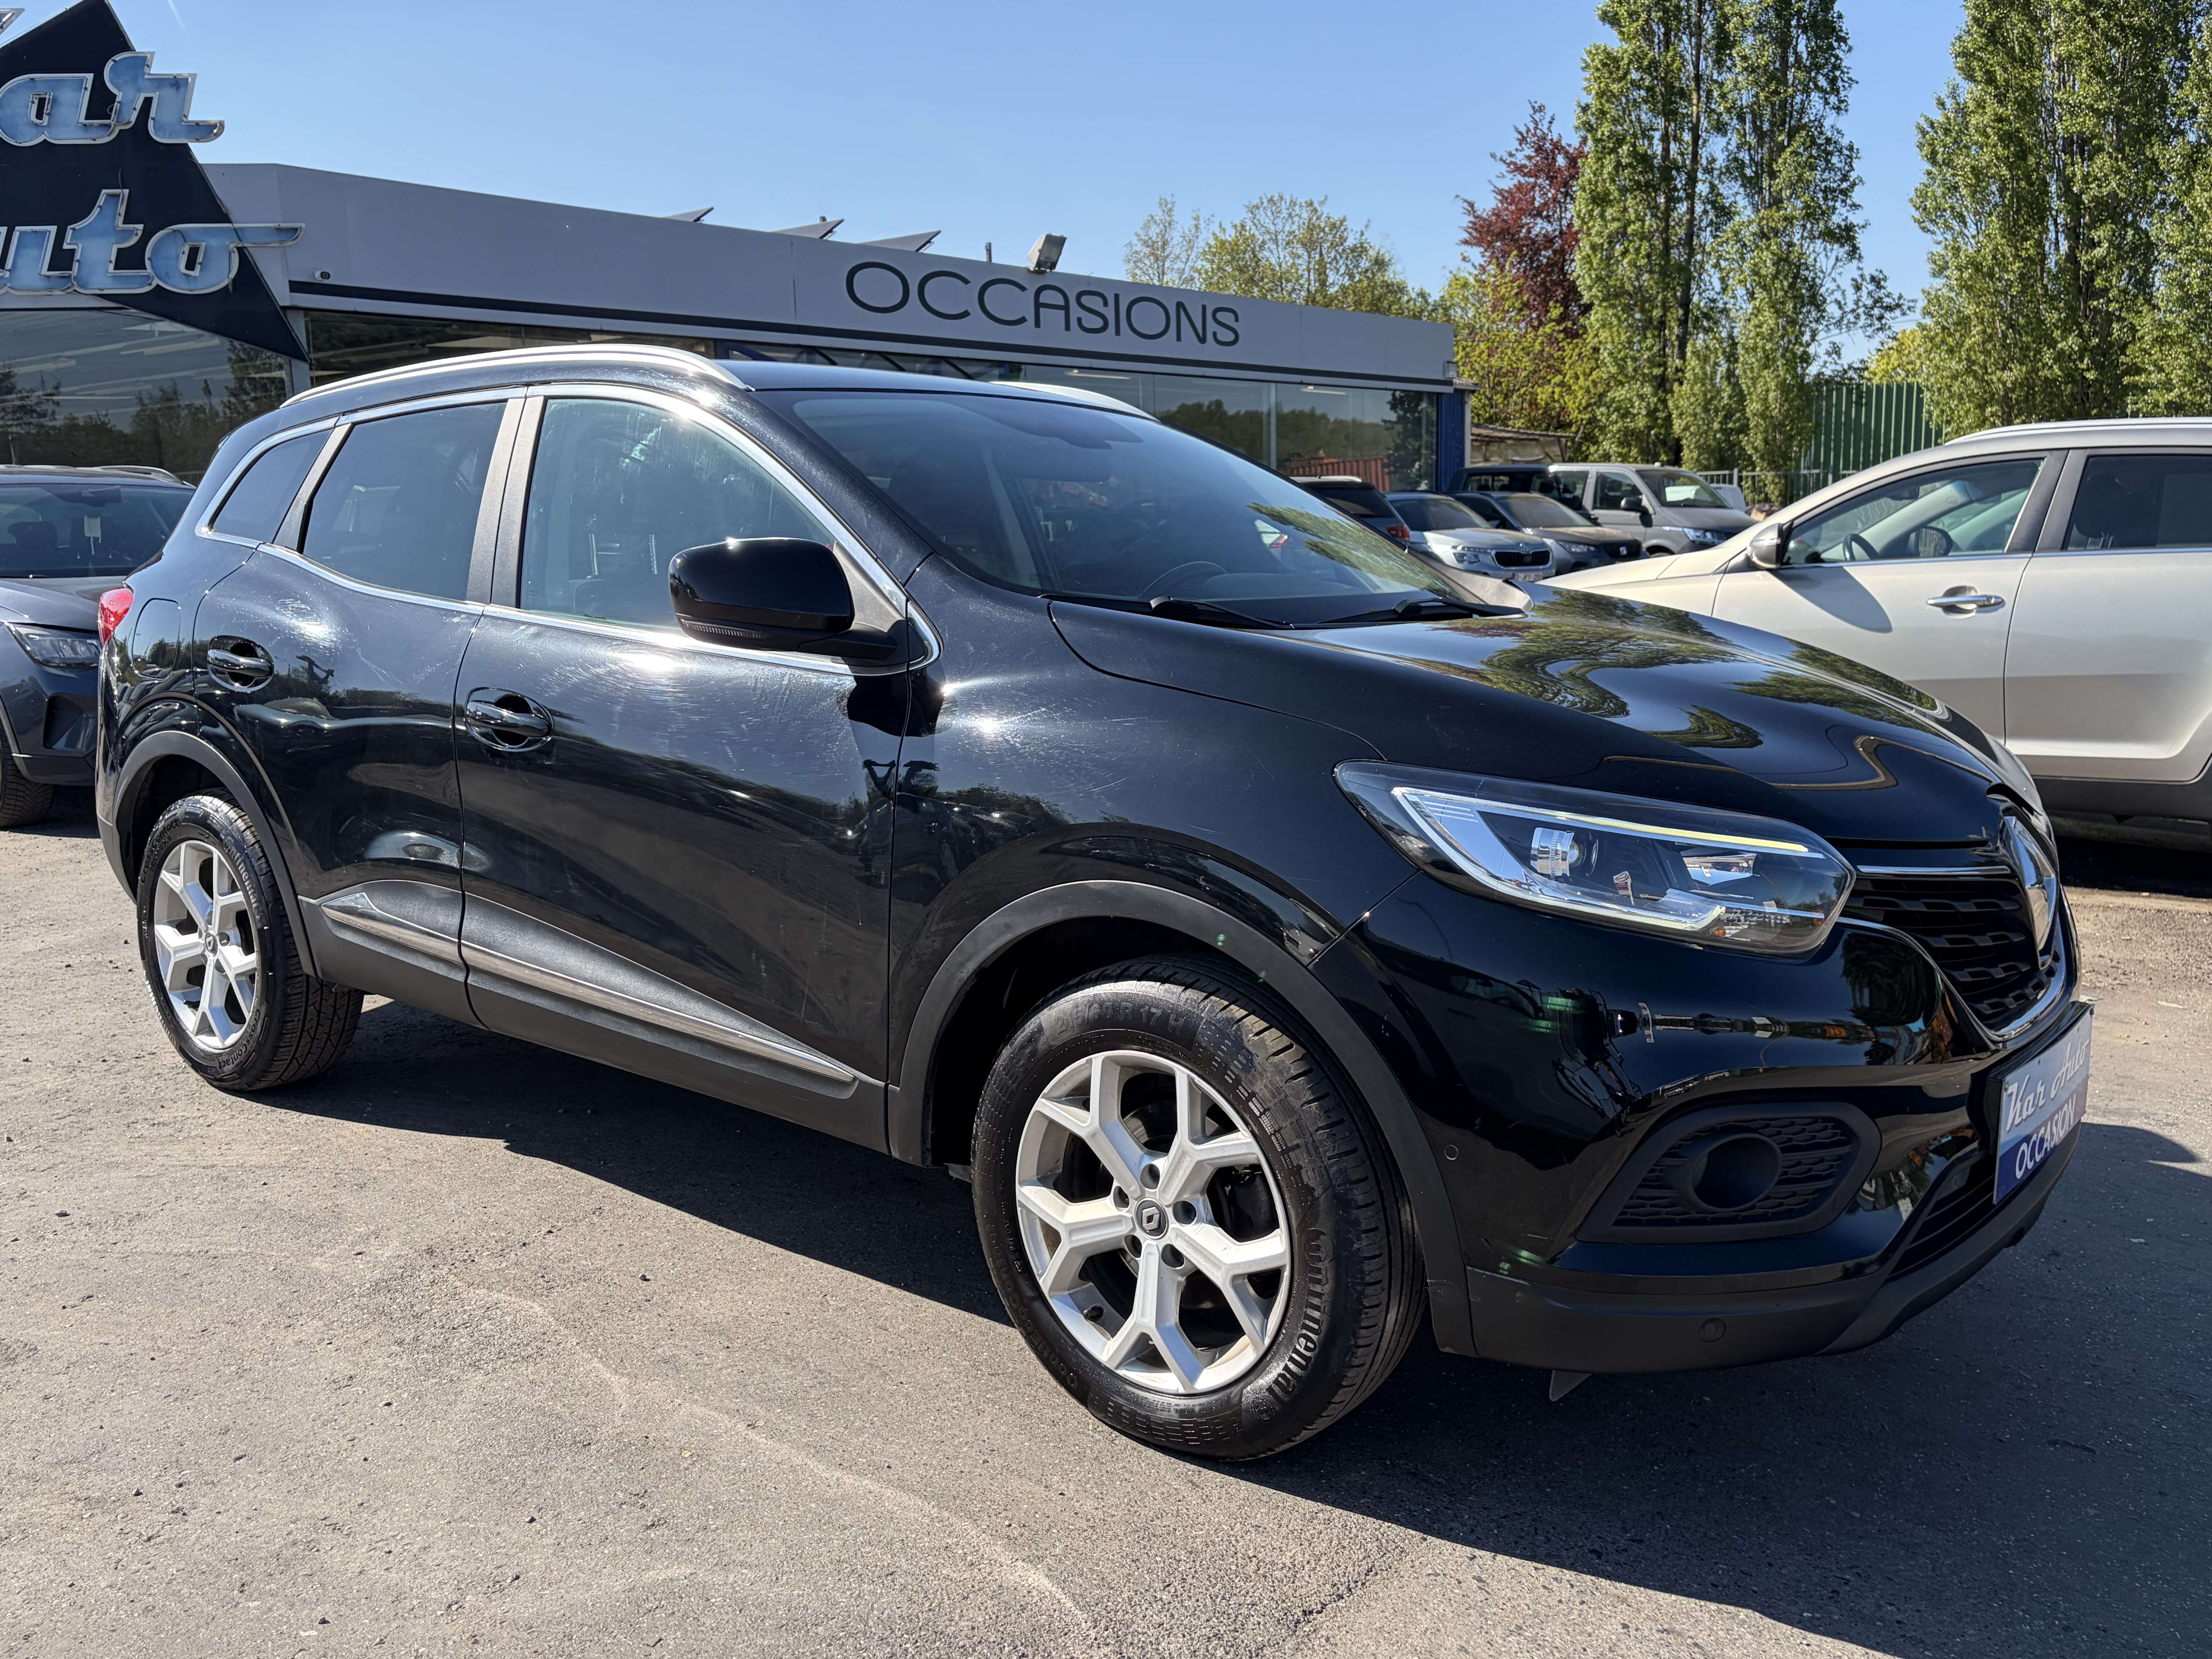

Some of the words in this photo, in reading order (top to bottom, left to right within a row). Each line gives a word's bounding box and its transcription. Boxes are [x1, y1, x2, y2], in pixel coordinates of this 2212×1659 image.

[0, 9, 225, 146] ar
[0, 189, 305, 294] uto
[846, 261, 1239, 347] OCCASIONS
[218, 1008, 261, 1070] CrossContact
[1054, 1002, 1114, 1035] 215/60
[1120, 1002, 1133, 1020] R
[1140, 1005, 1162, 1026] 17
[1167, 1013, 1185, 1036] H
[2006, 1074, 2047, 1133] Kar
[2051, 1039, 2090, 1096] Auto
[2015, 1094, 2077, 1180] OCCASION
[989, 1224, 1079, 1389] ContiEcoCon
[1266, 1228, 1335, 1407] Continental
